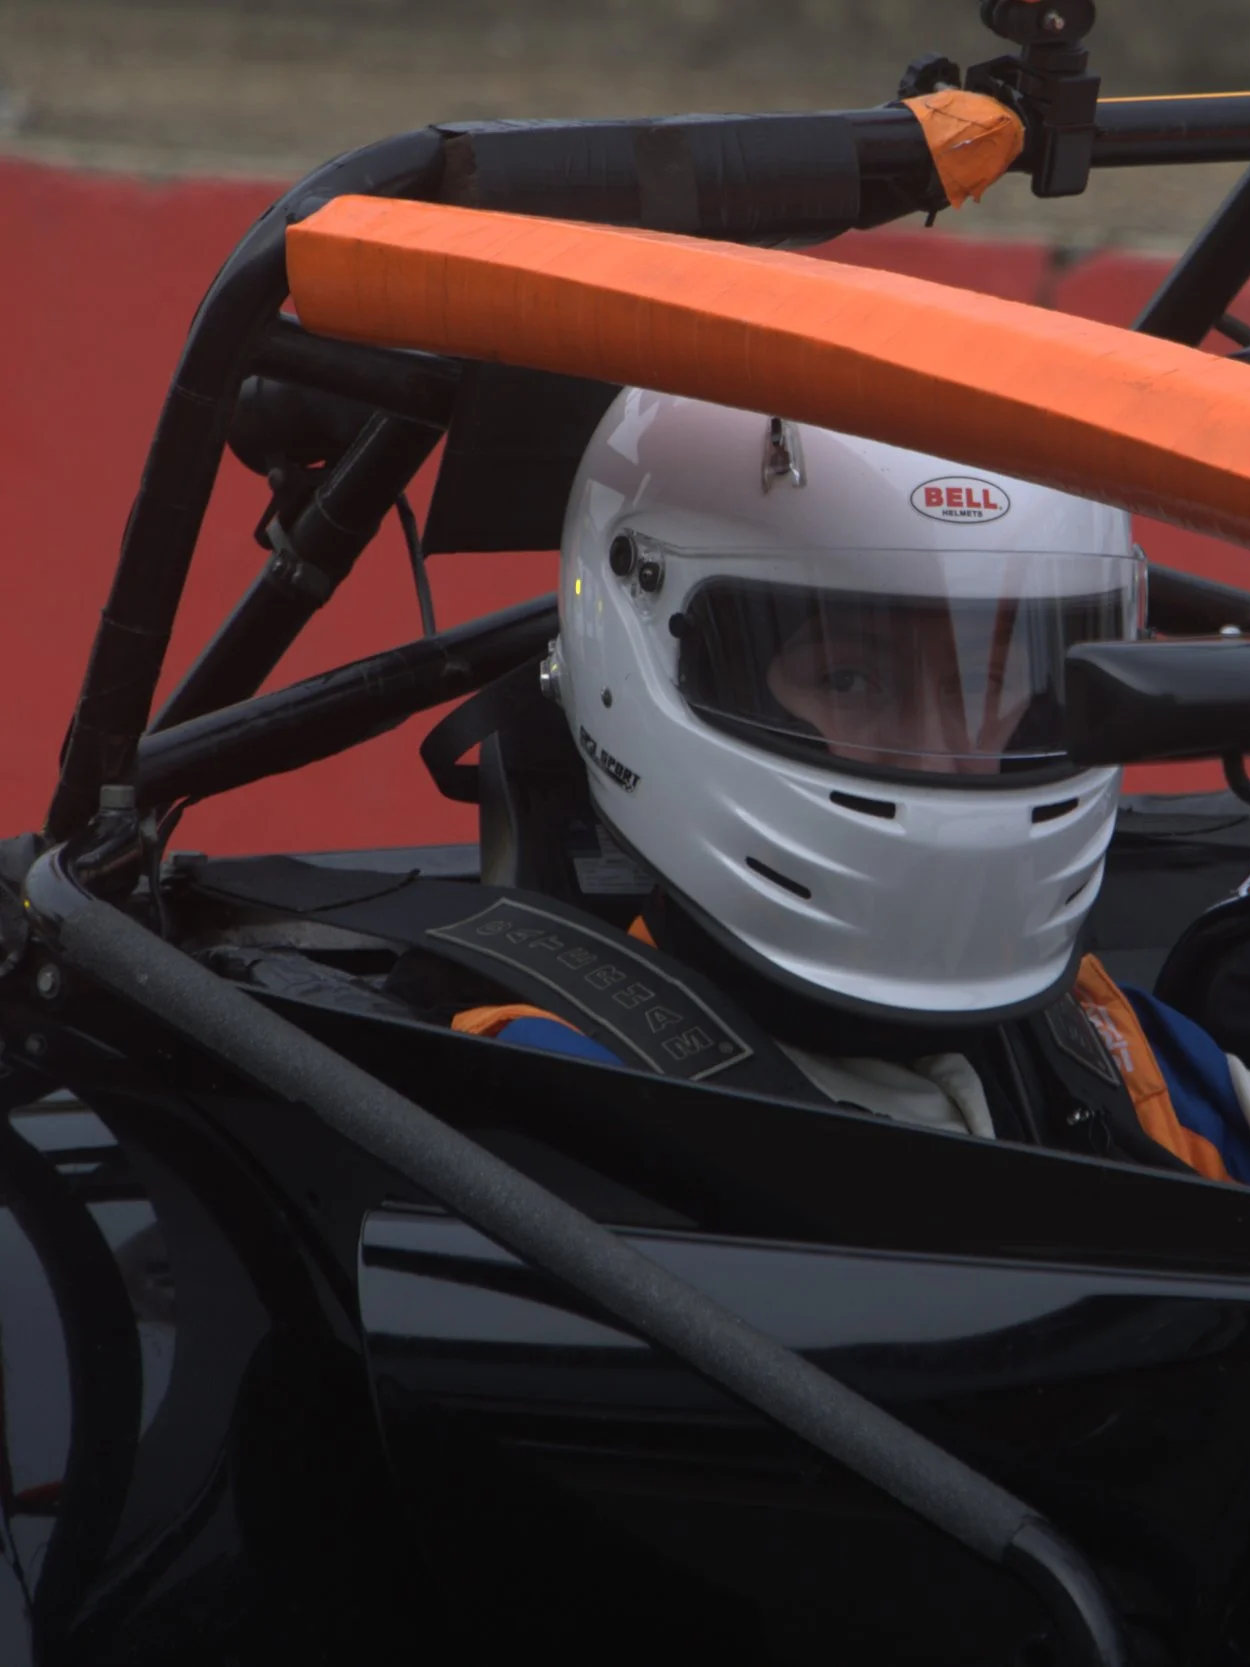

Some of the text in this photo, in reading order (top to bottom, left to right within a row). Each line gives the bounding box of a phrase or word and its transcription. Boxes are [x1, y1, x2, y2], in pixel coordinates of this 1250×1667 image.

[923, 486, 999, 511] BELL
[941, 508, 984, 518] HELMETS
[475, 919, 715, 1061] CATERHAM
